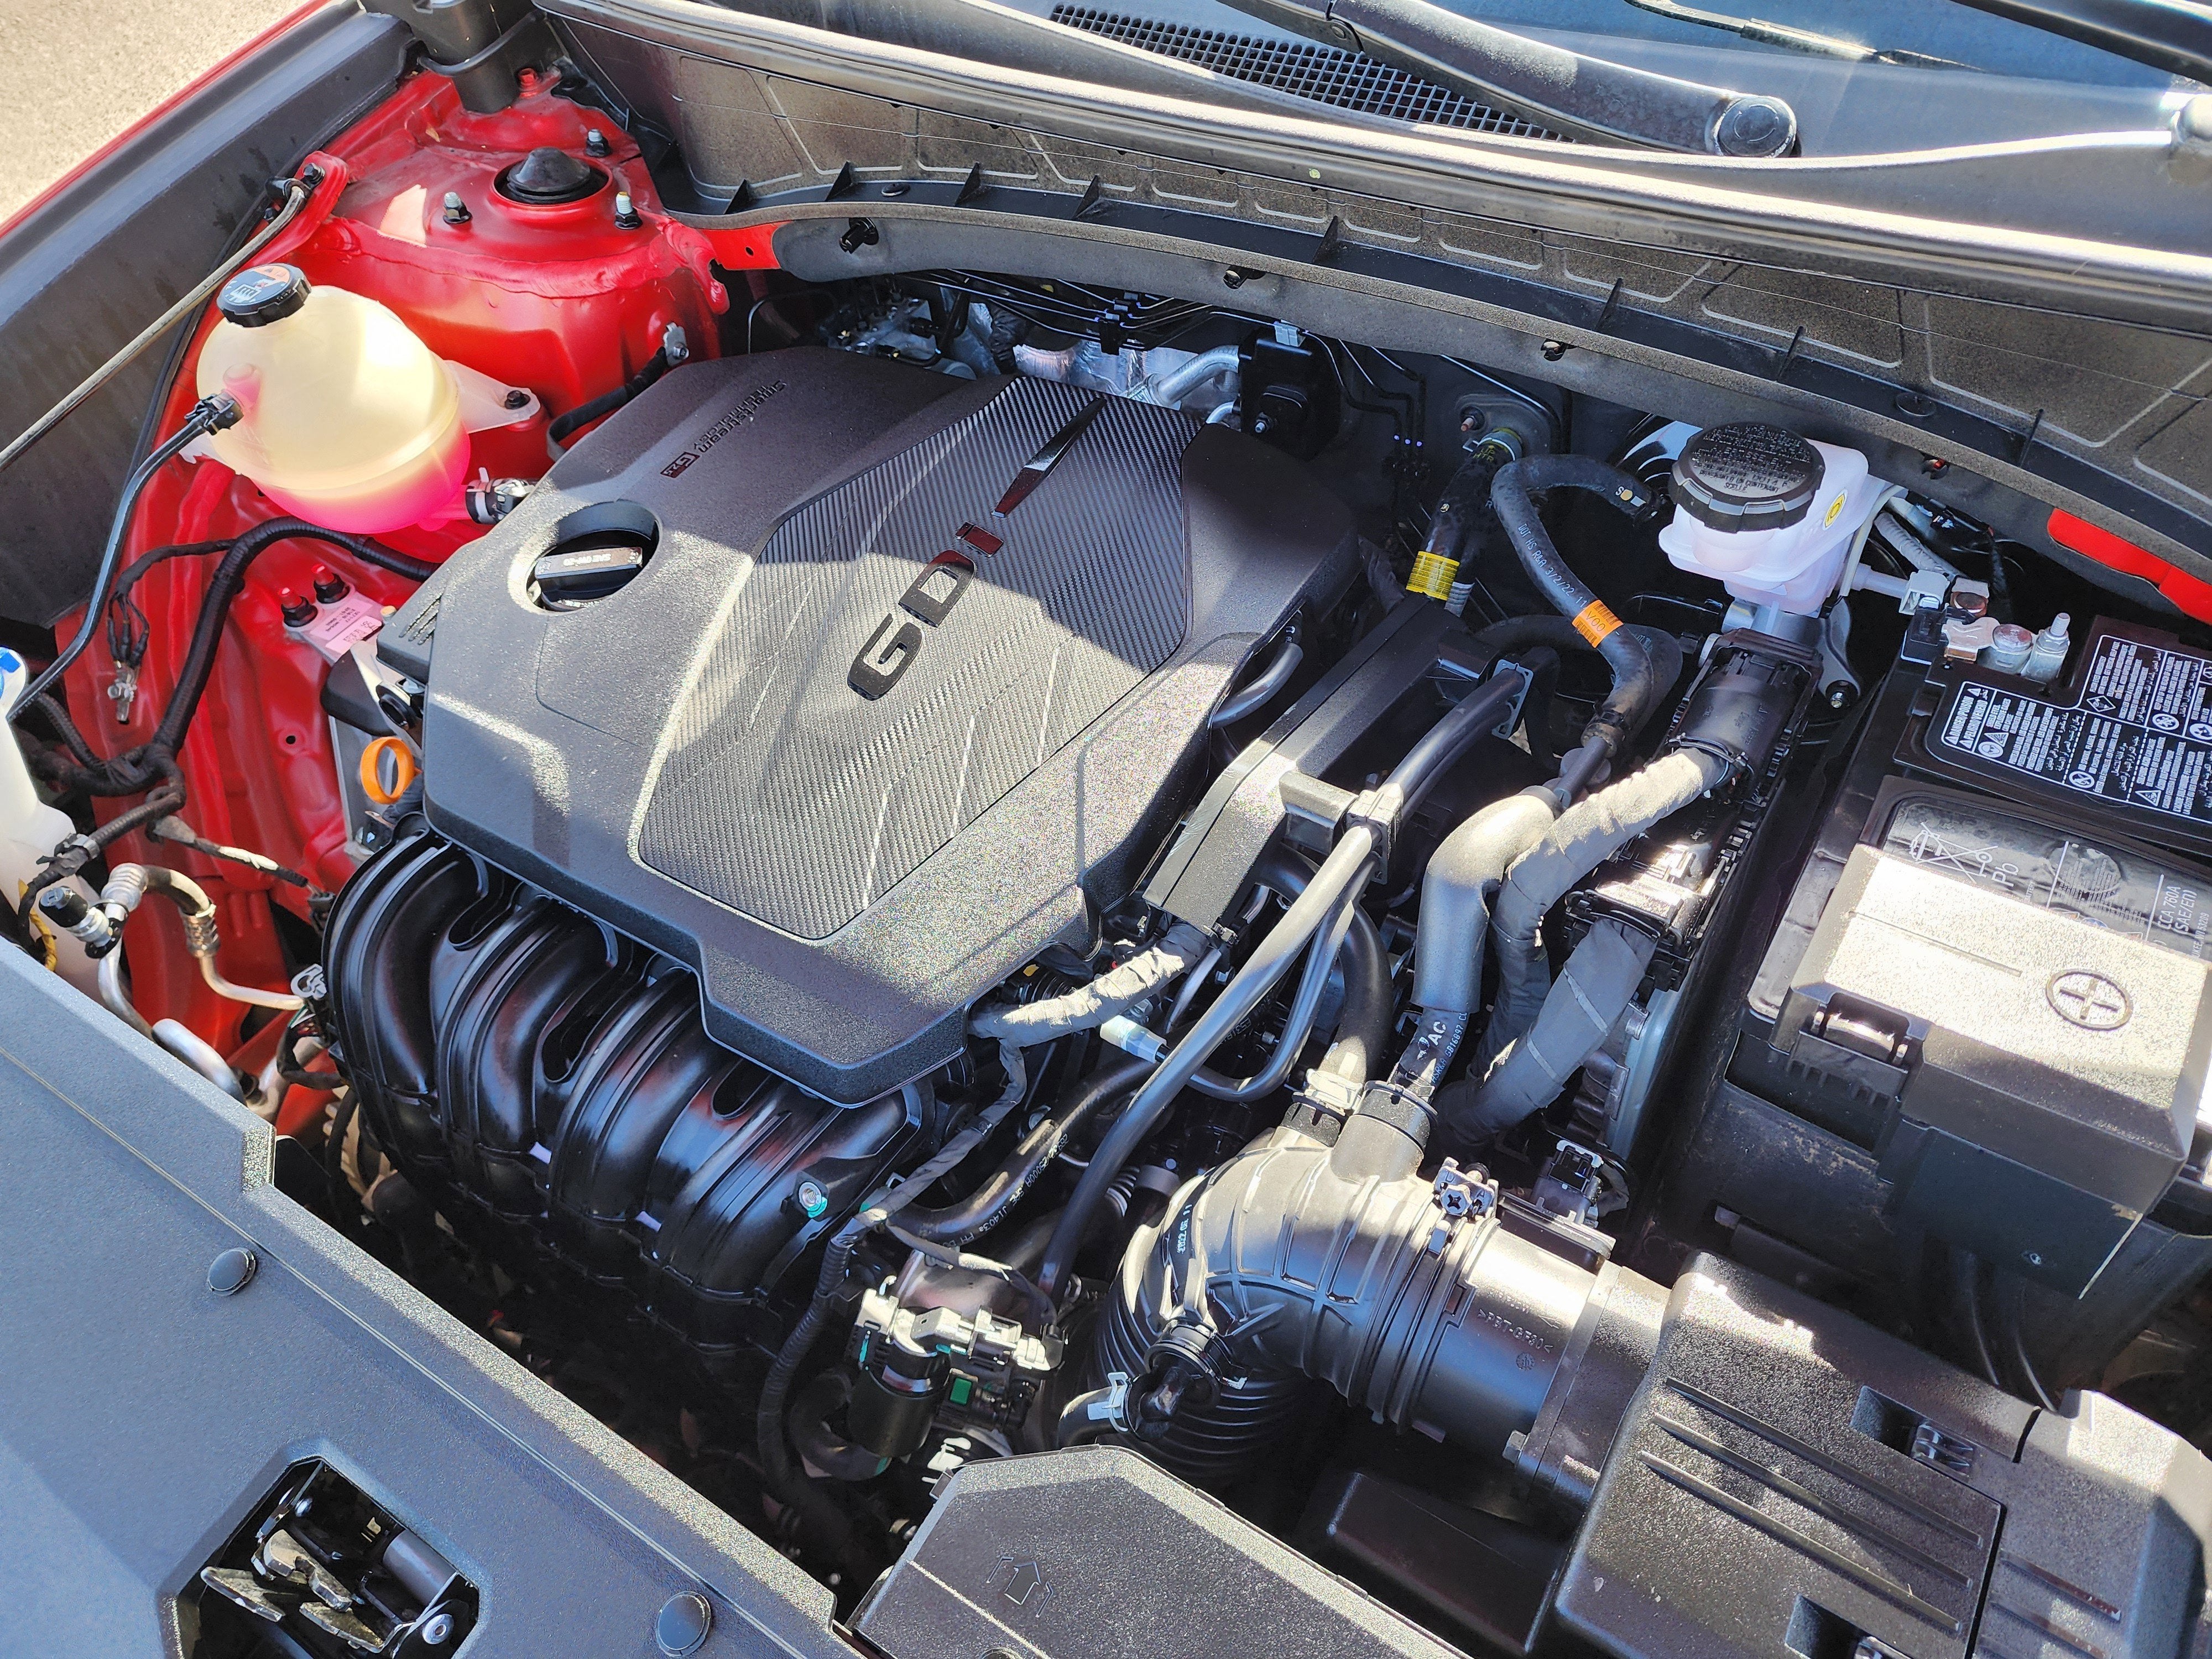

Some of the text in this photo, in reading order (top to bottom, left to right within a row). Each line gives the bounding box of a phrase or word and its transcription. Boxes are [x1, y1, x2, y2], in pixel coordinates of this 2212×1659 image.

[697, 379, 787, 455] Smartstream
[1991, 859, 2020, 887] Pb
[2163, 886, 2181, 908] 760A
[1425, 1019, 1448, 1046] AC
[1443, 1024, 1464, 1058] GB16897
